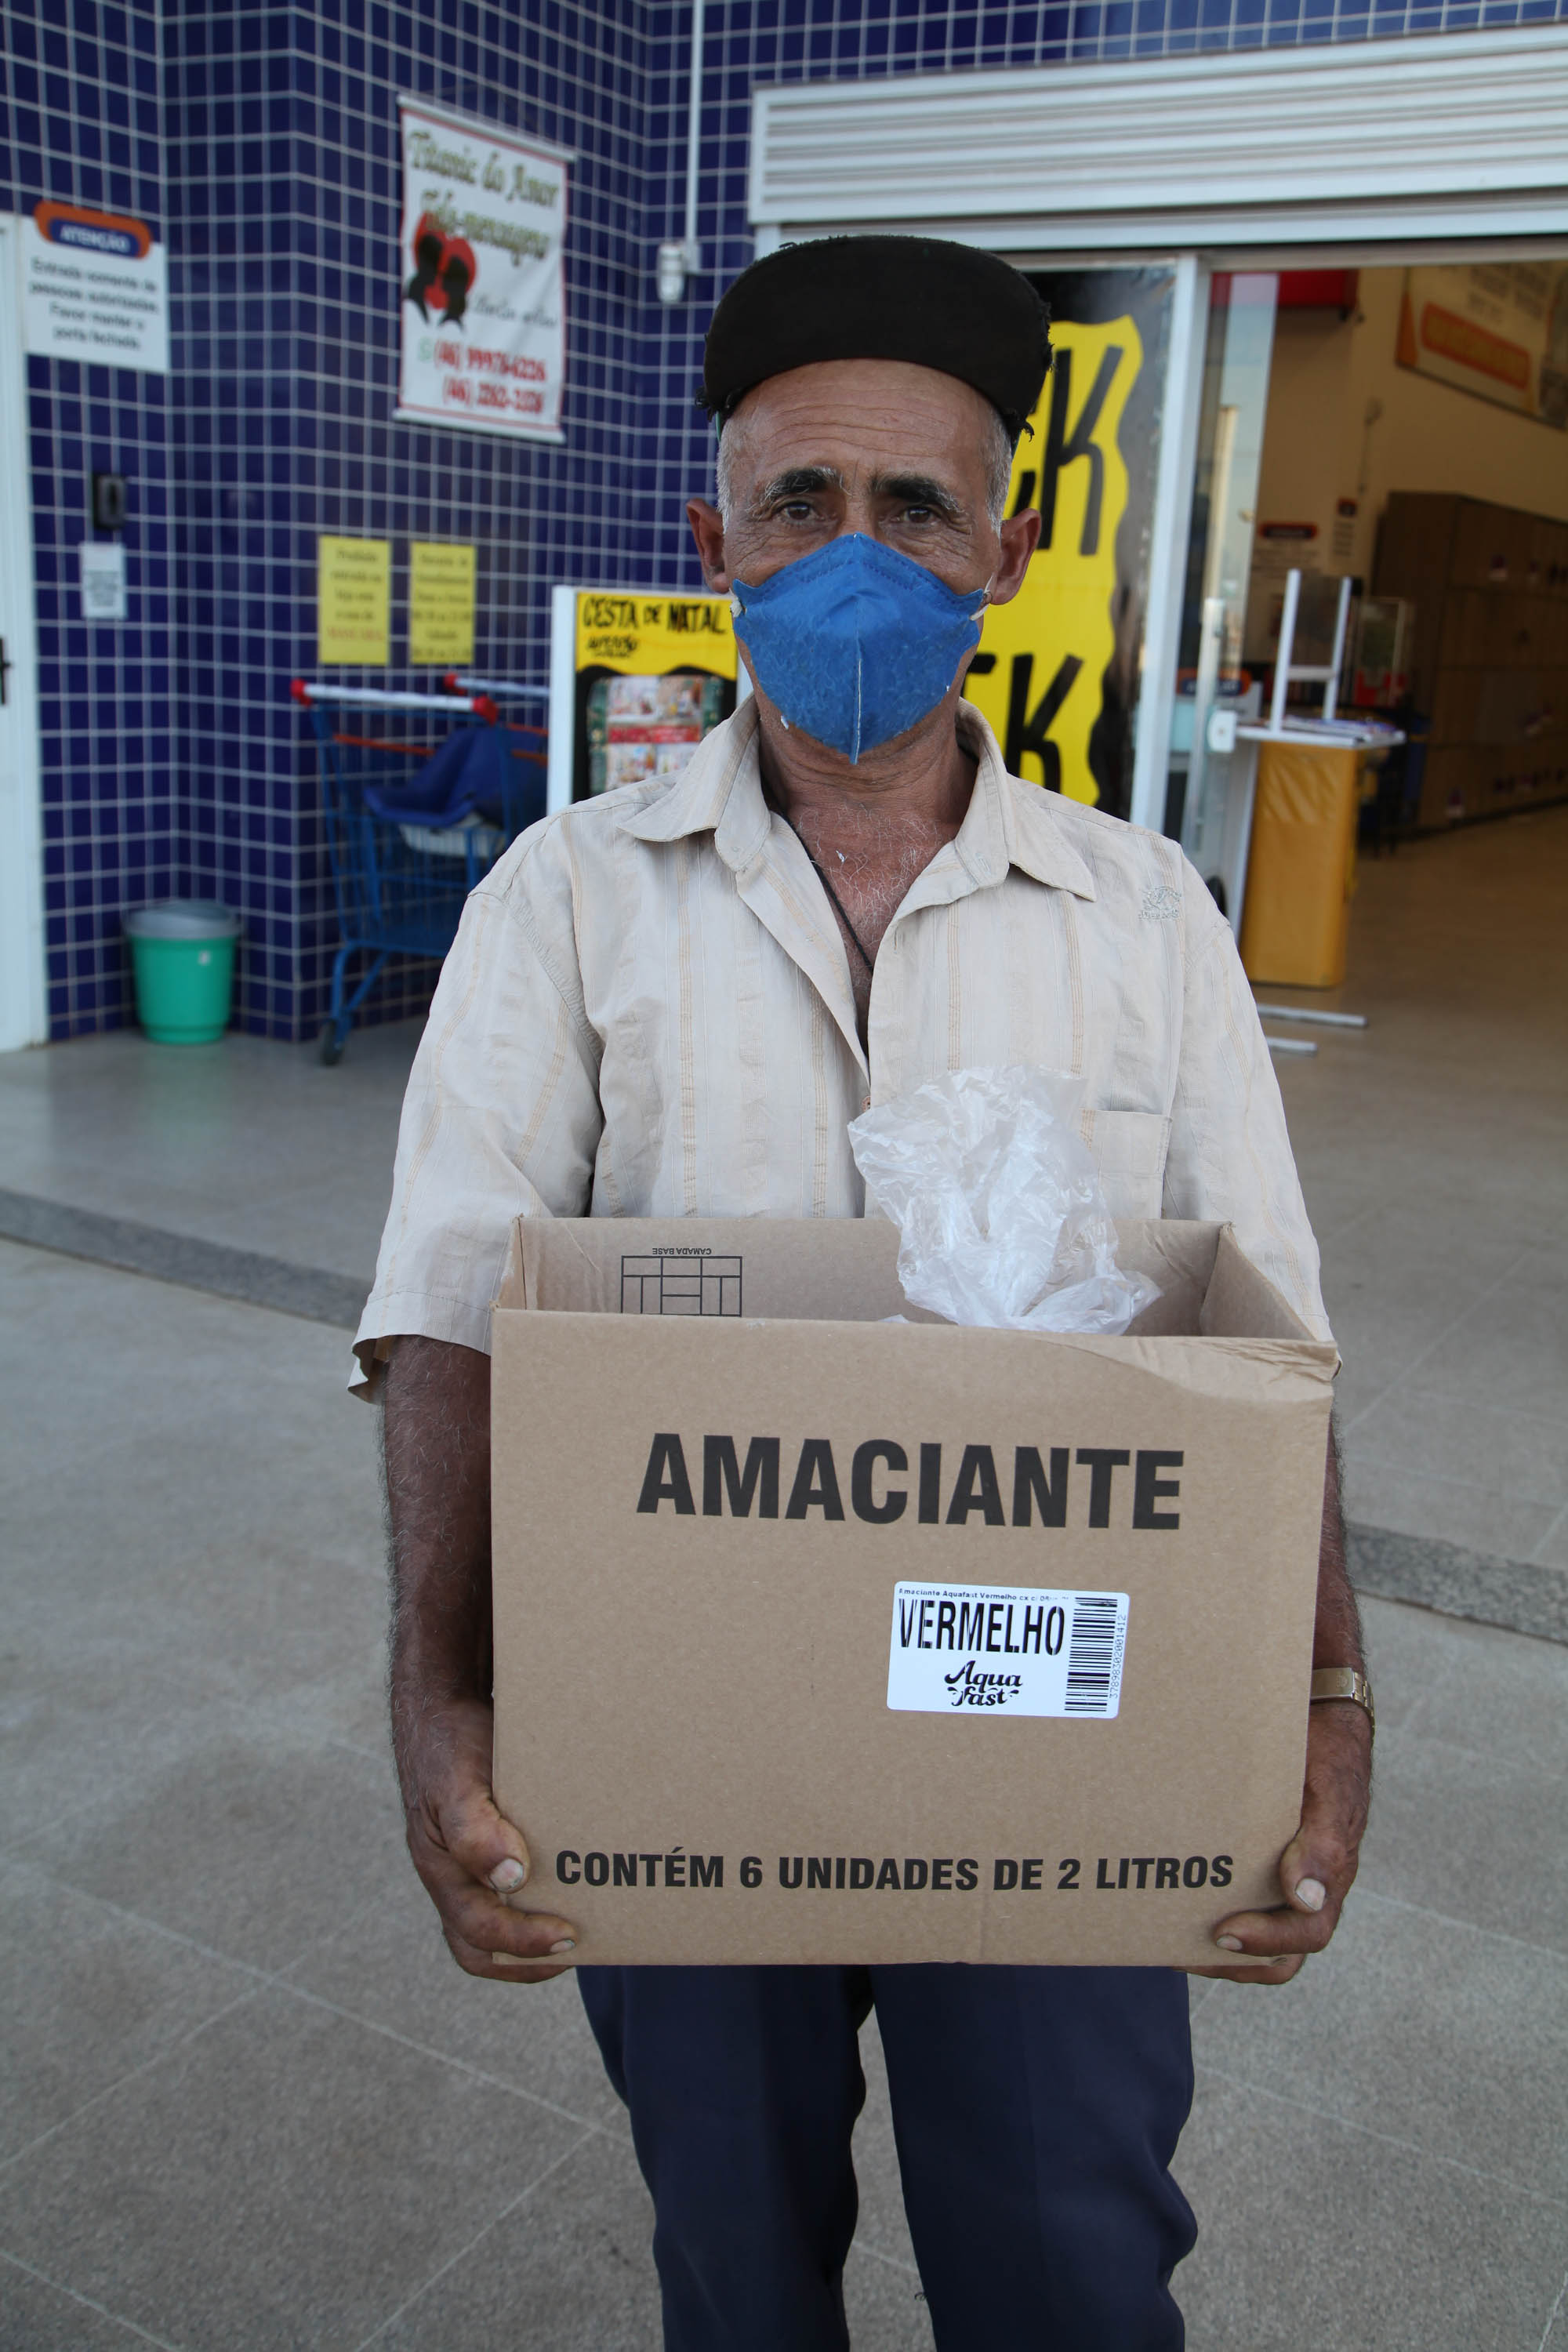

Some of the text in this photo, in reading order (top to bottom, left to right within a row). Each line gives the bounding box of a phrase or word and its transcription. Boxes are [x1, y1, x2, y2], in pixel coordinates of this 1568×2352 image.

[583, 597, 726, 636] CESTA DE NATAL
[636, 1432, 1185, 1530] AMACIANTE
[980, 1592, 1017, 1601] Vermelho
[898, 1597, 1065, 1656] VERMELHO
[944, 1660, 1023, 1693] Aqua
[1109, 1614, 1127, 1699] 37898302001412
[556, 1846, 1234, 1891] CONTÉM 6 UNIDADES DE 2 LITROS
